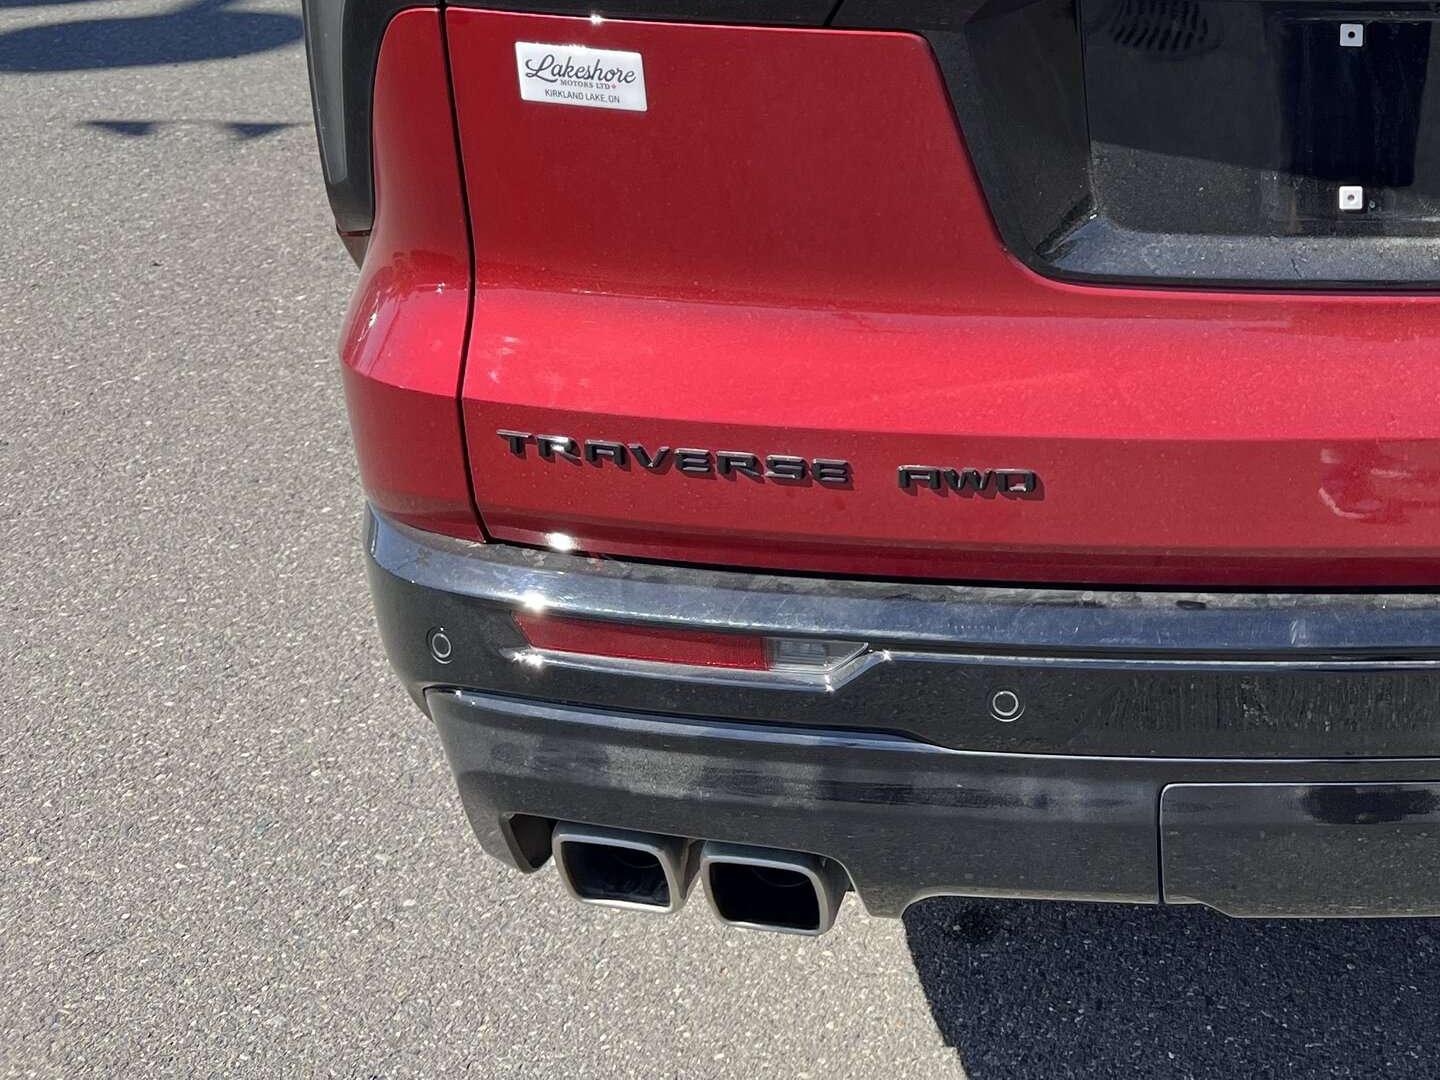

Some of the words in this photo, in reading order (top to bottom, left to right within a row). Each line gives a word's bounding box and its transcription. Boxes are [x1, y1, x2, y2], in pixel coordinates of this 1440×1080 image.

[525, 54, 636, 83] Lakeshore
[560, 80, 594, 88] MOTORS
[596, 82, 610, 90] LTD
[545, 89, 584, 100] KIRKLAND
[585, 93, 607, 103] LAKE,
[609, 95, 620, 103] ON
[496, 428, 853, 485] TRAVERSE
[899, 464, 1040, 495] AWD
